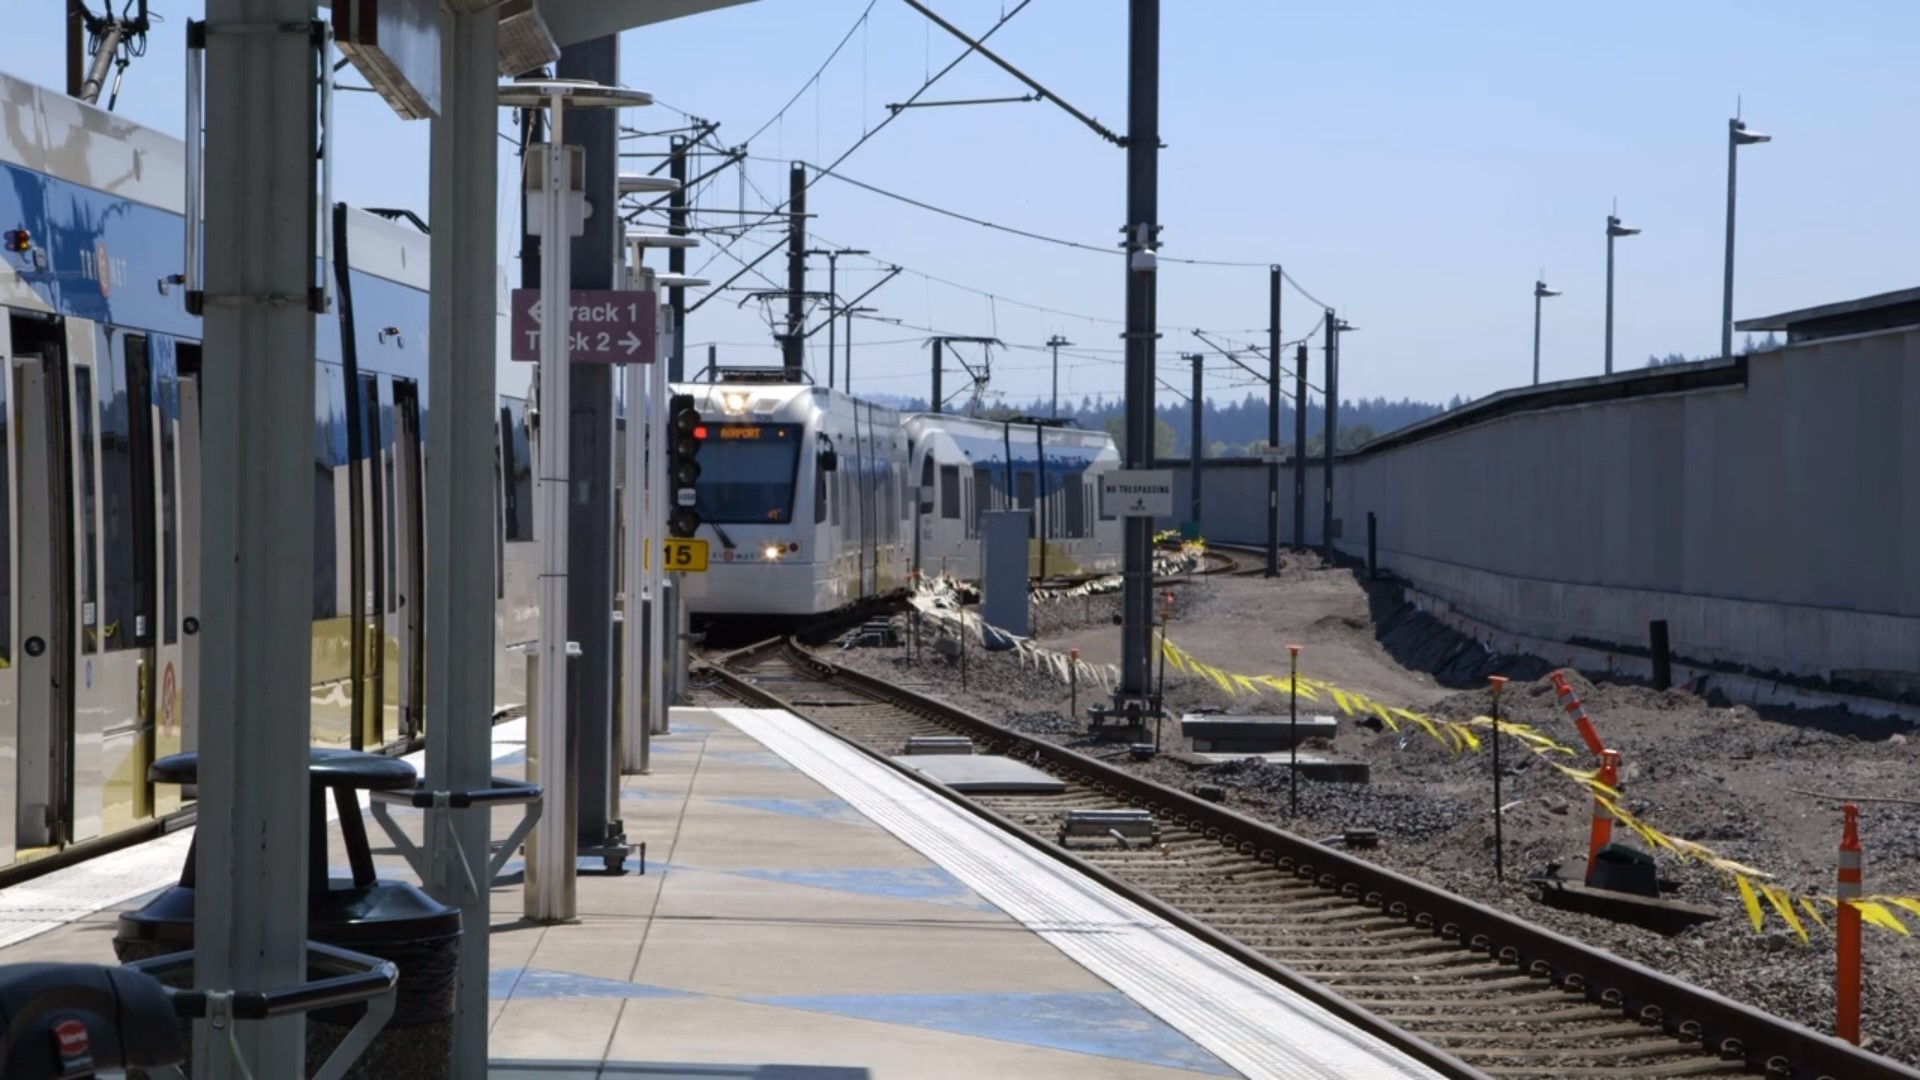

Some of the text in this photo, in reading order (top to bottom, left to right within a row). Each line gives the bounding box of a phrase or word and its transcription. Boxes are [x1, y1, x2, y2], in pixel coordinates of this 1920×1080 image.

[569, 303, 637, 322] rack 1
[525, 331, 610, 351] Tck 2
[721, 428, 760, 438] AIRPORT
[1106, 485, 1169, 493] NO TRESPASSING
[664, 545, 692, 566] 15
